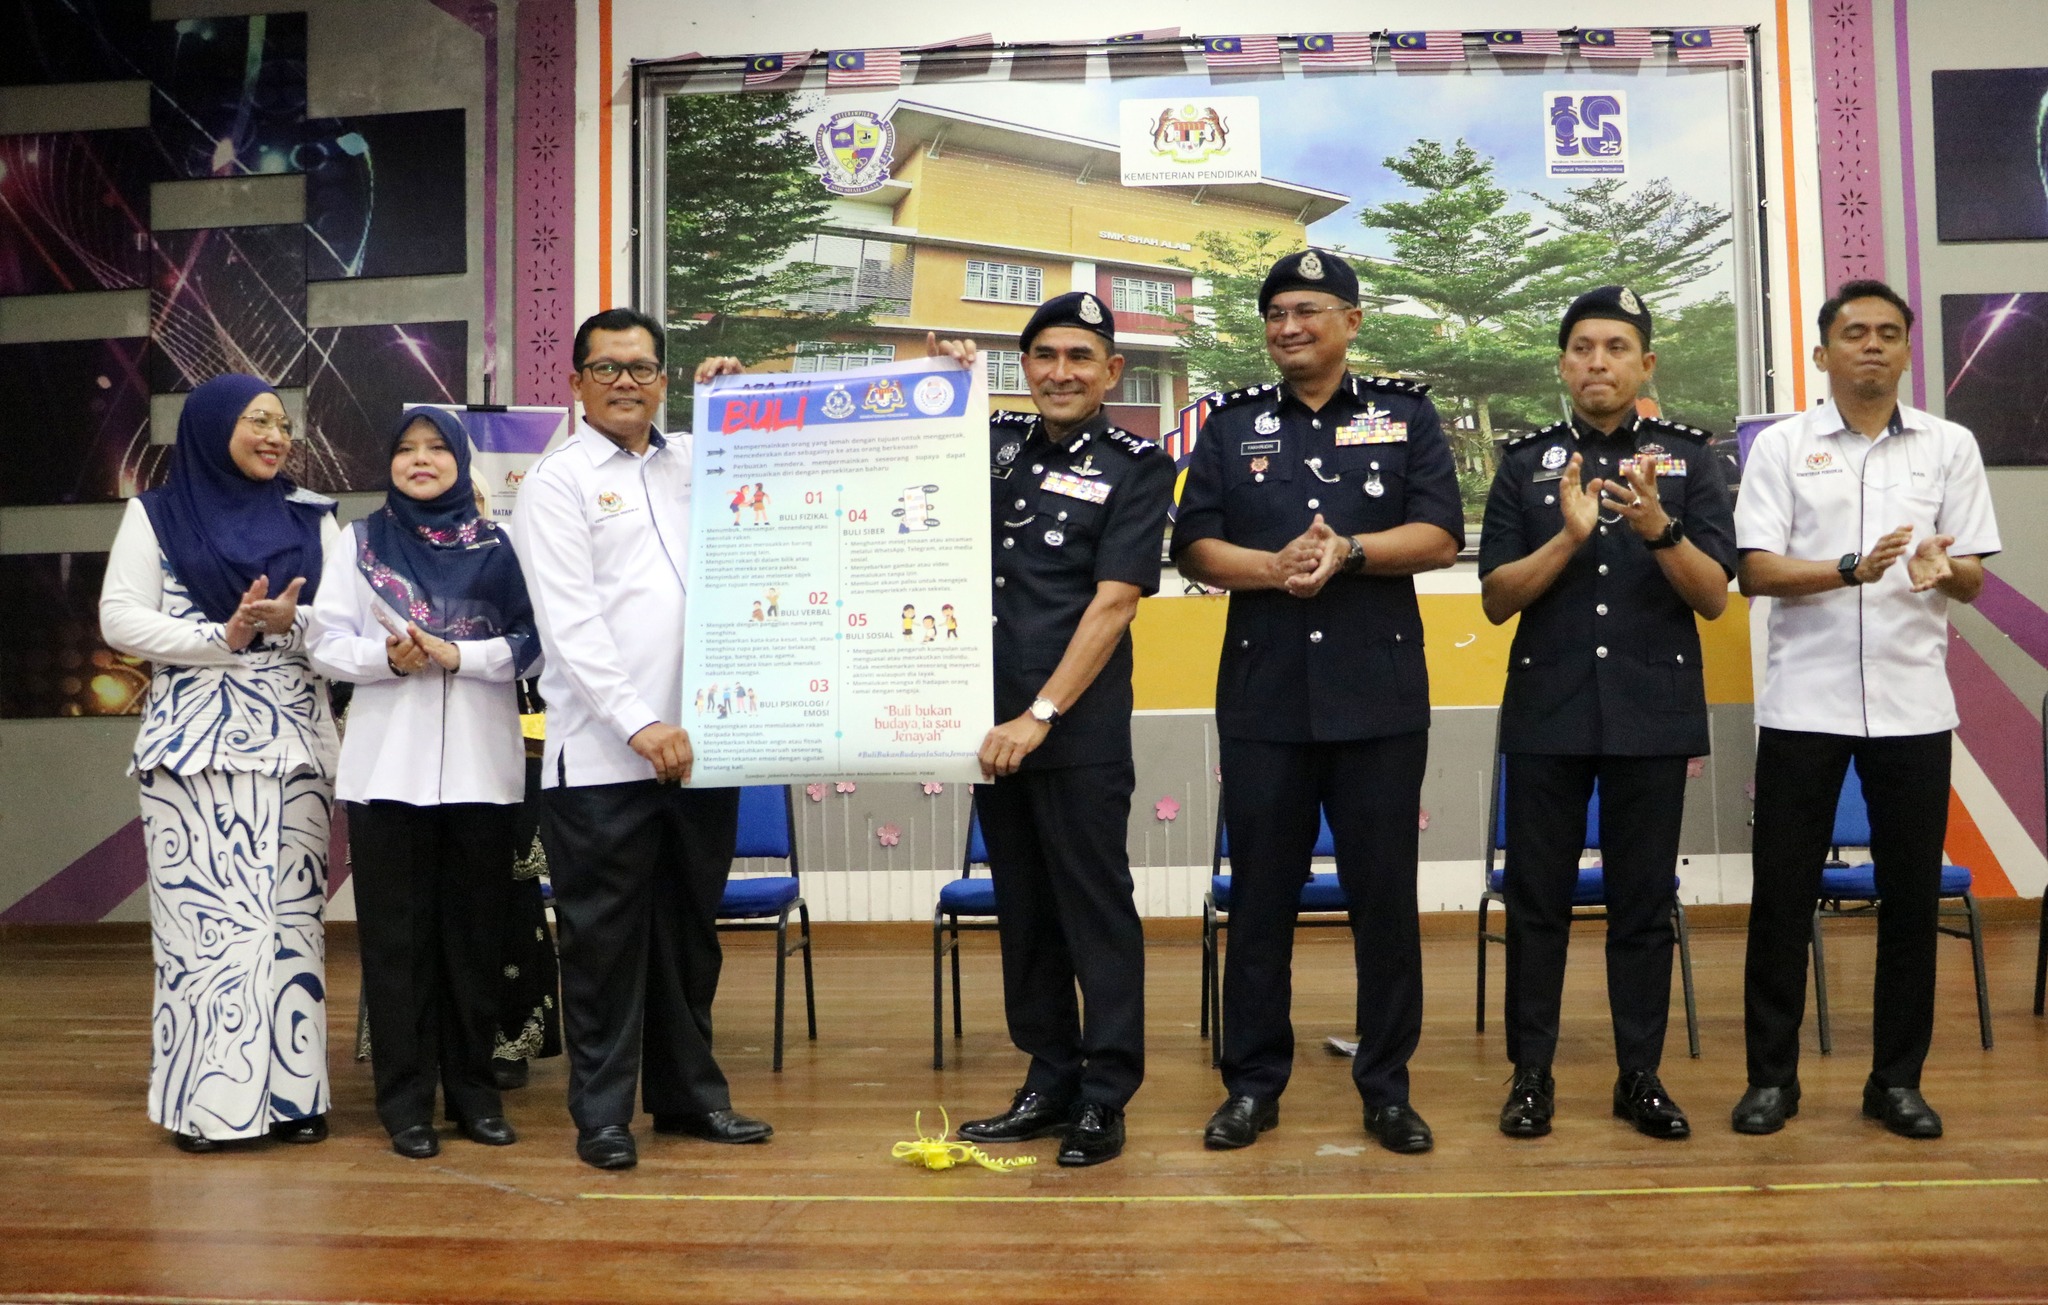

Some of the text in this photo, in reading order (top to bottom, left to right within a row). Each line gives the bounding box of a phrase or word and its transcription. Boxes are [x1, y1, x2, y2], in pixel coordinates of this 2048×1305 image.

[1600, 140, 1620, 154] 25
[1124, 170, 1258, 181] KEMENTERIAN PENDIDIKAN
[1098, 230, 1192, 252] SMK SHAH ALAM
[722, 396, 807, 435] BULI
[805, 491, 823, 504] 01
[780, 513, 828, 521] BULI FIZIKAL
[848, 509, 868, 522] 04
[843, 527, 885, 536] BULI SIBER
[808, 592, 828, 605] 02
[781, 609, 831, 617] BULI VERBAL
[848, 614, 867, 626] 05
[846, 632, 894, 640] BULI SOSIAL
[809, 679, 829, 692] 03
[760, 700, 778, 708] BULI
[781, 700, 824, 708] PSIKOLOGI
[916, 704, 952, 716] bukan
[922, 717, 932, 728] ia
[935, 718, 961, 728] satu
